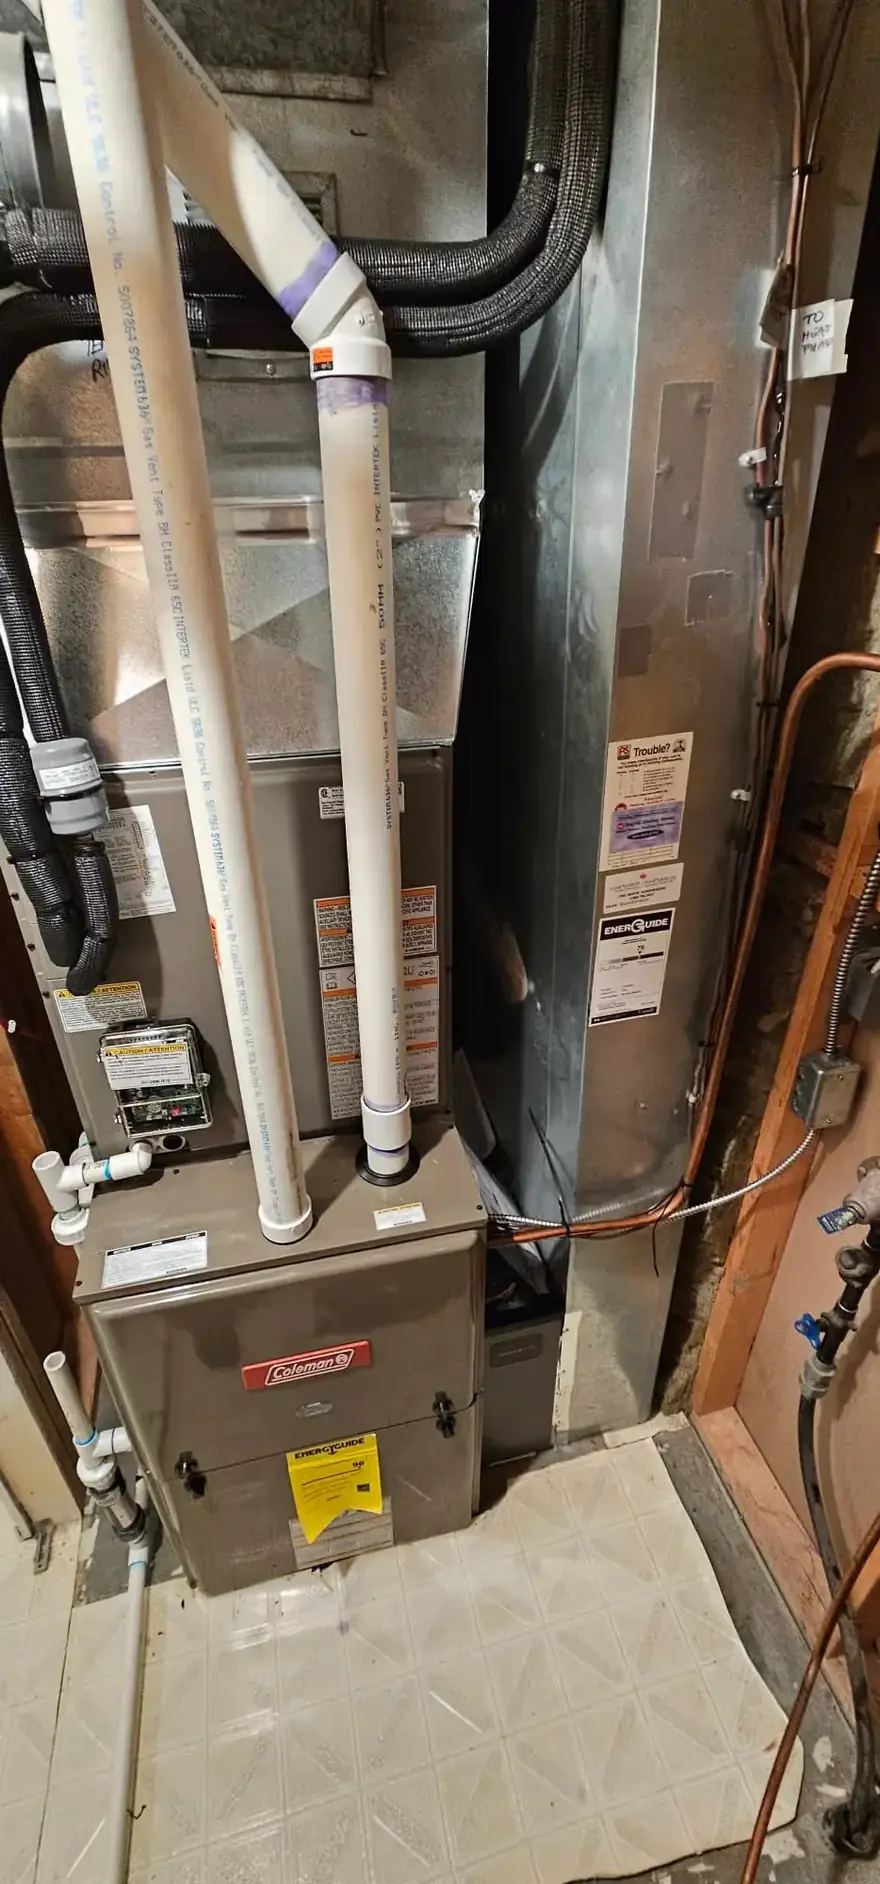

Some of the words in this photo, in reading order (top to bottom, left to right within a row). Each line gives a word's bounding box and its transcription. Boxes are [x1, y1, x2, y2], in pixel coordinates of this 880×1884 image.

[98, 180, 120, 243] Control
[111, 251, 124, 276] No.
[803, 310, 824, 325] TO
[141, 426, 155, 449] Gas
[146, 455, 160, 482] Vent
[150, 489, 166, 516] Type
[157, 521, 169, 536] BH
[195, 741, 211, 776] Control
[633, 743, 670, 757] Trouble?
[100, 984, 136, 993] ATTENTION
[148, 1045, 184, 1053] ATTENTION
[273, 1358, 334, 1380] Coleman
[295, 1438, 364, 1459] ENERGYGUIDE
